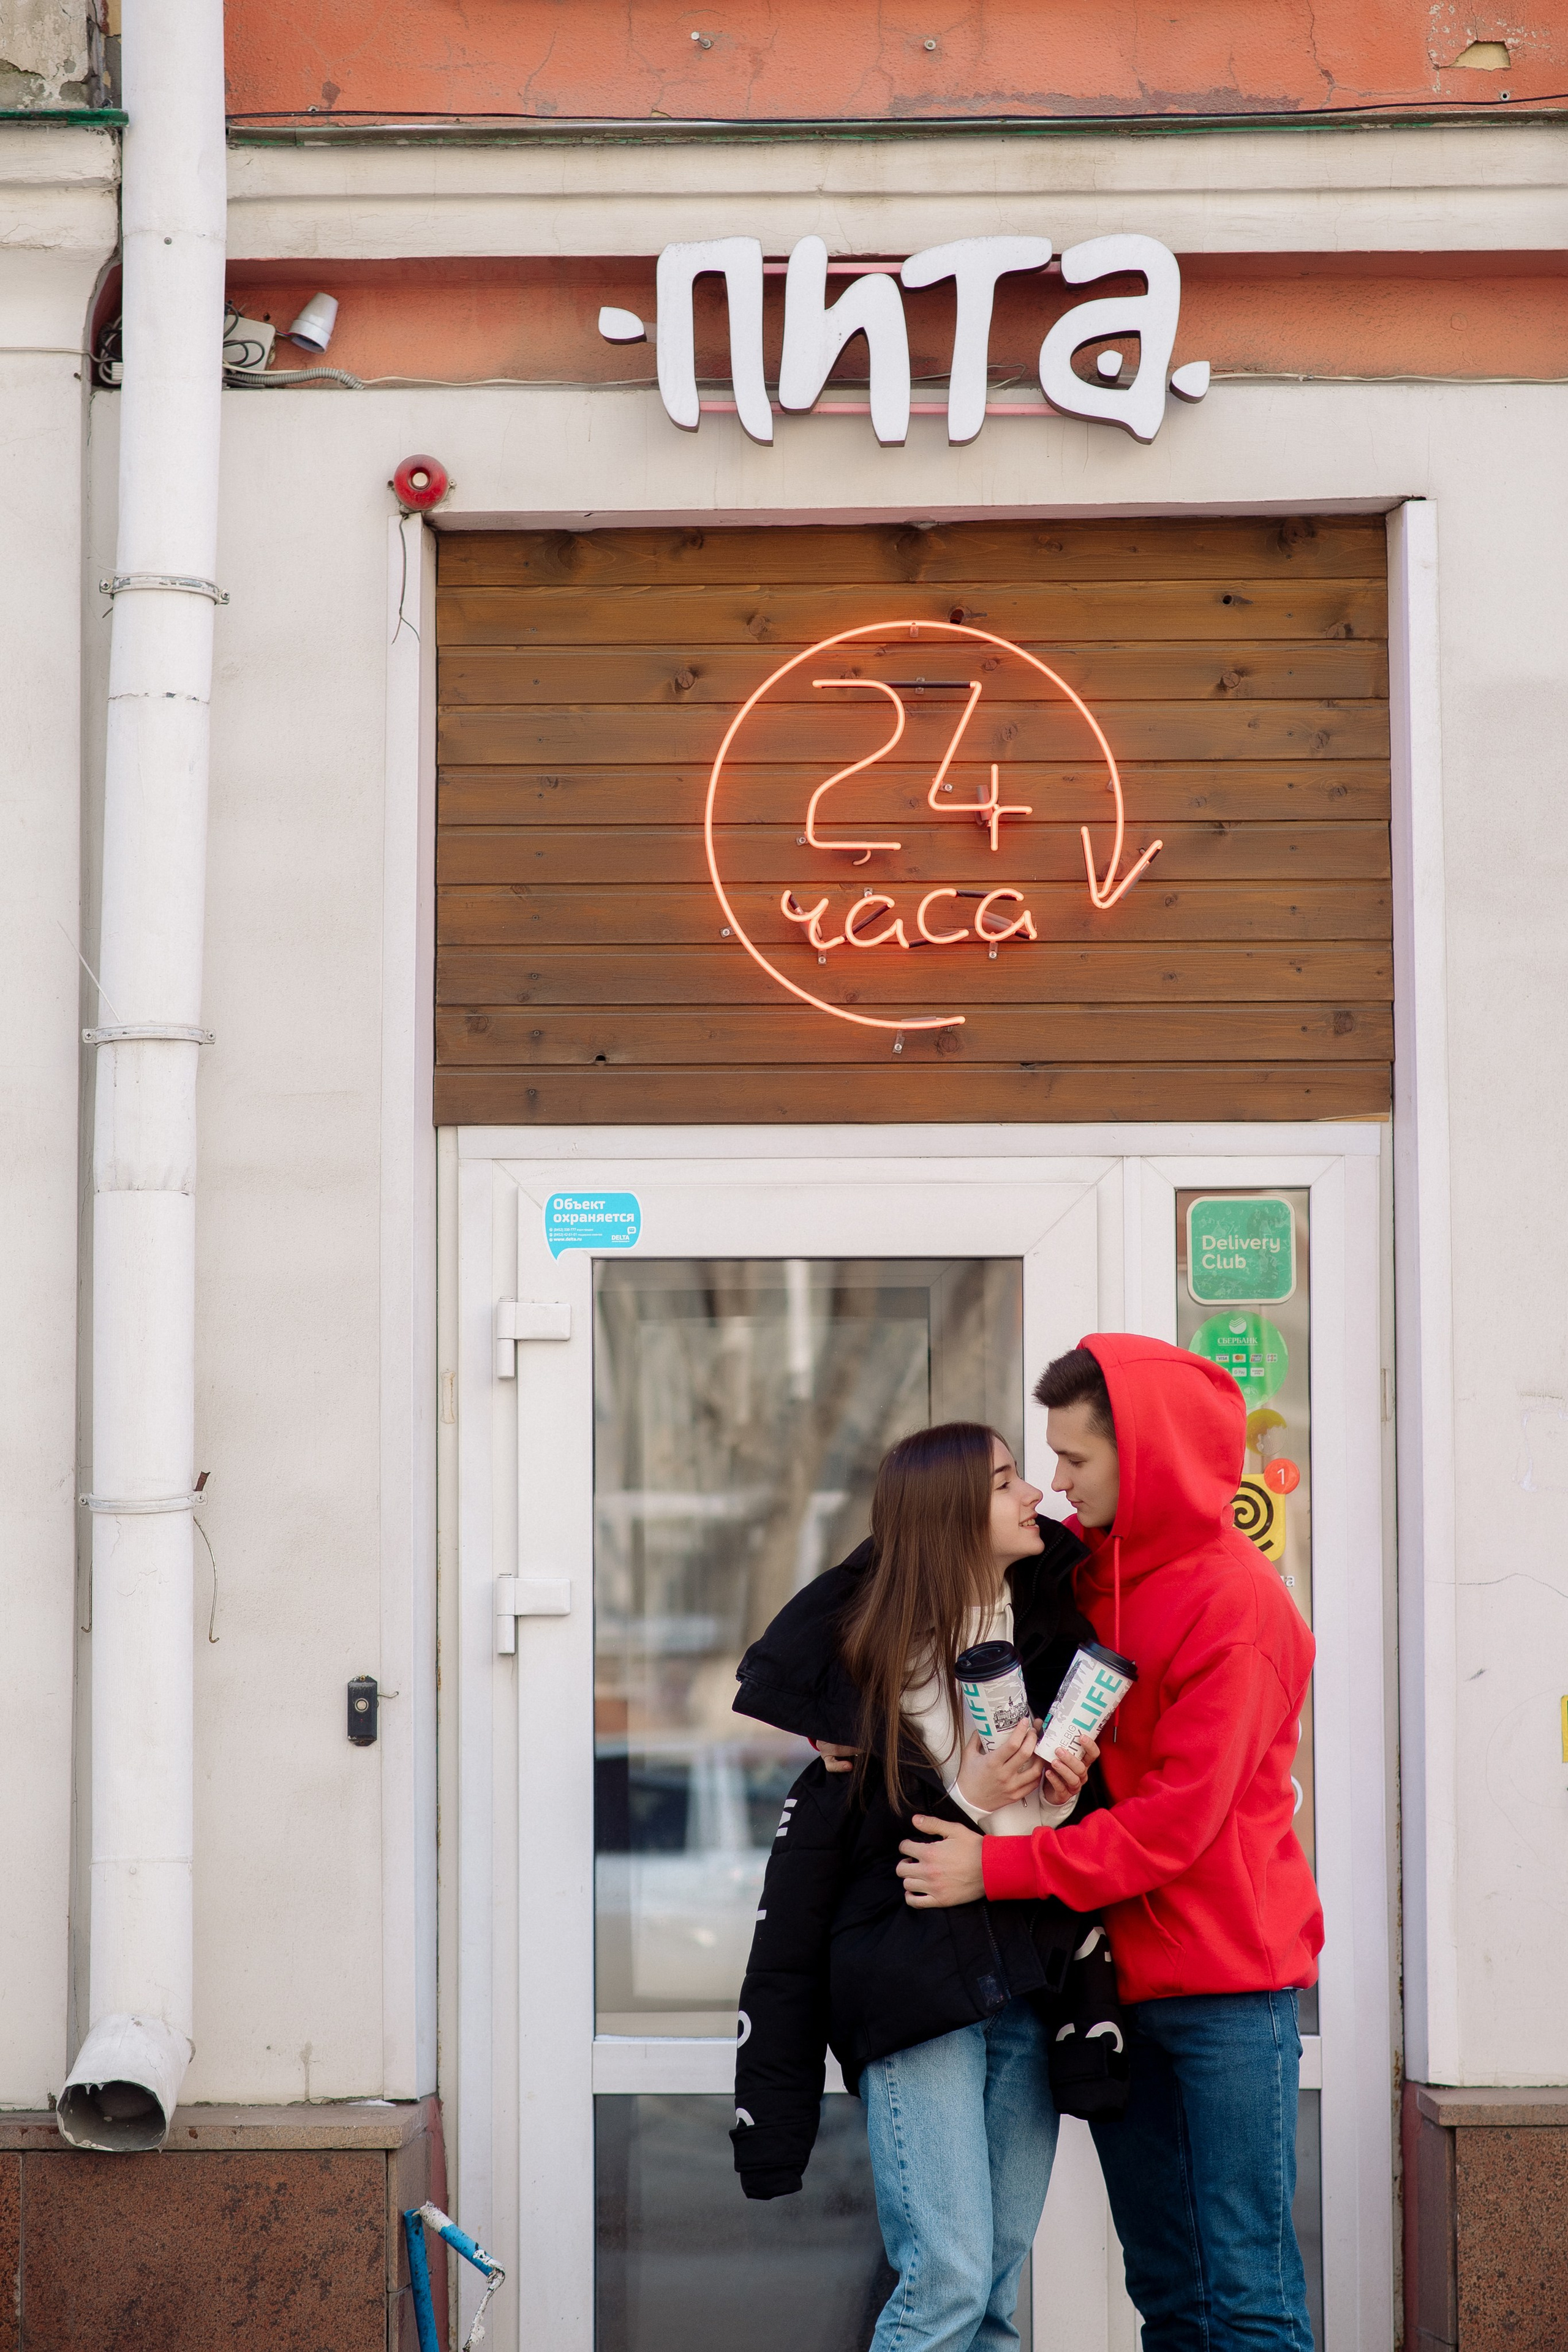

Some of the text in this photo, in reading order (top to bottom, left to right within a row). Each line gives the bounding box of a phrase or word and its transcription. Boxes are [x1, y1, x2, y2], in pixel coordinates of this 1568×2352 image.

[806, 679, 1035, 851] 24
[780, 888, 1038, 949] часа
[553, 1197, 606, 1210] Объект
[553, 1213, 635, 1226] охраняется
[1202, 1235, 1281, 1253] Delivery
[1202, 1254, 1247, 1270] Club
[1277, 1468, 1285, 1485] 1
[1072, 1668, 1123, 1732] LIFE
[960, 1681, 993, 1737] LIFE
[1064, 1724, 1076, 1740] BIG
